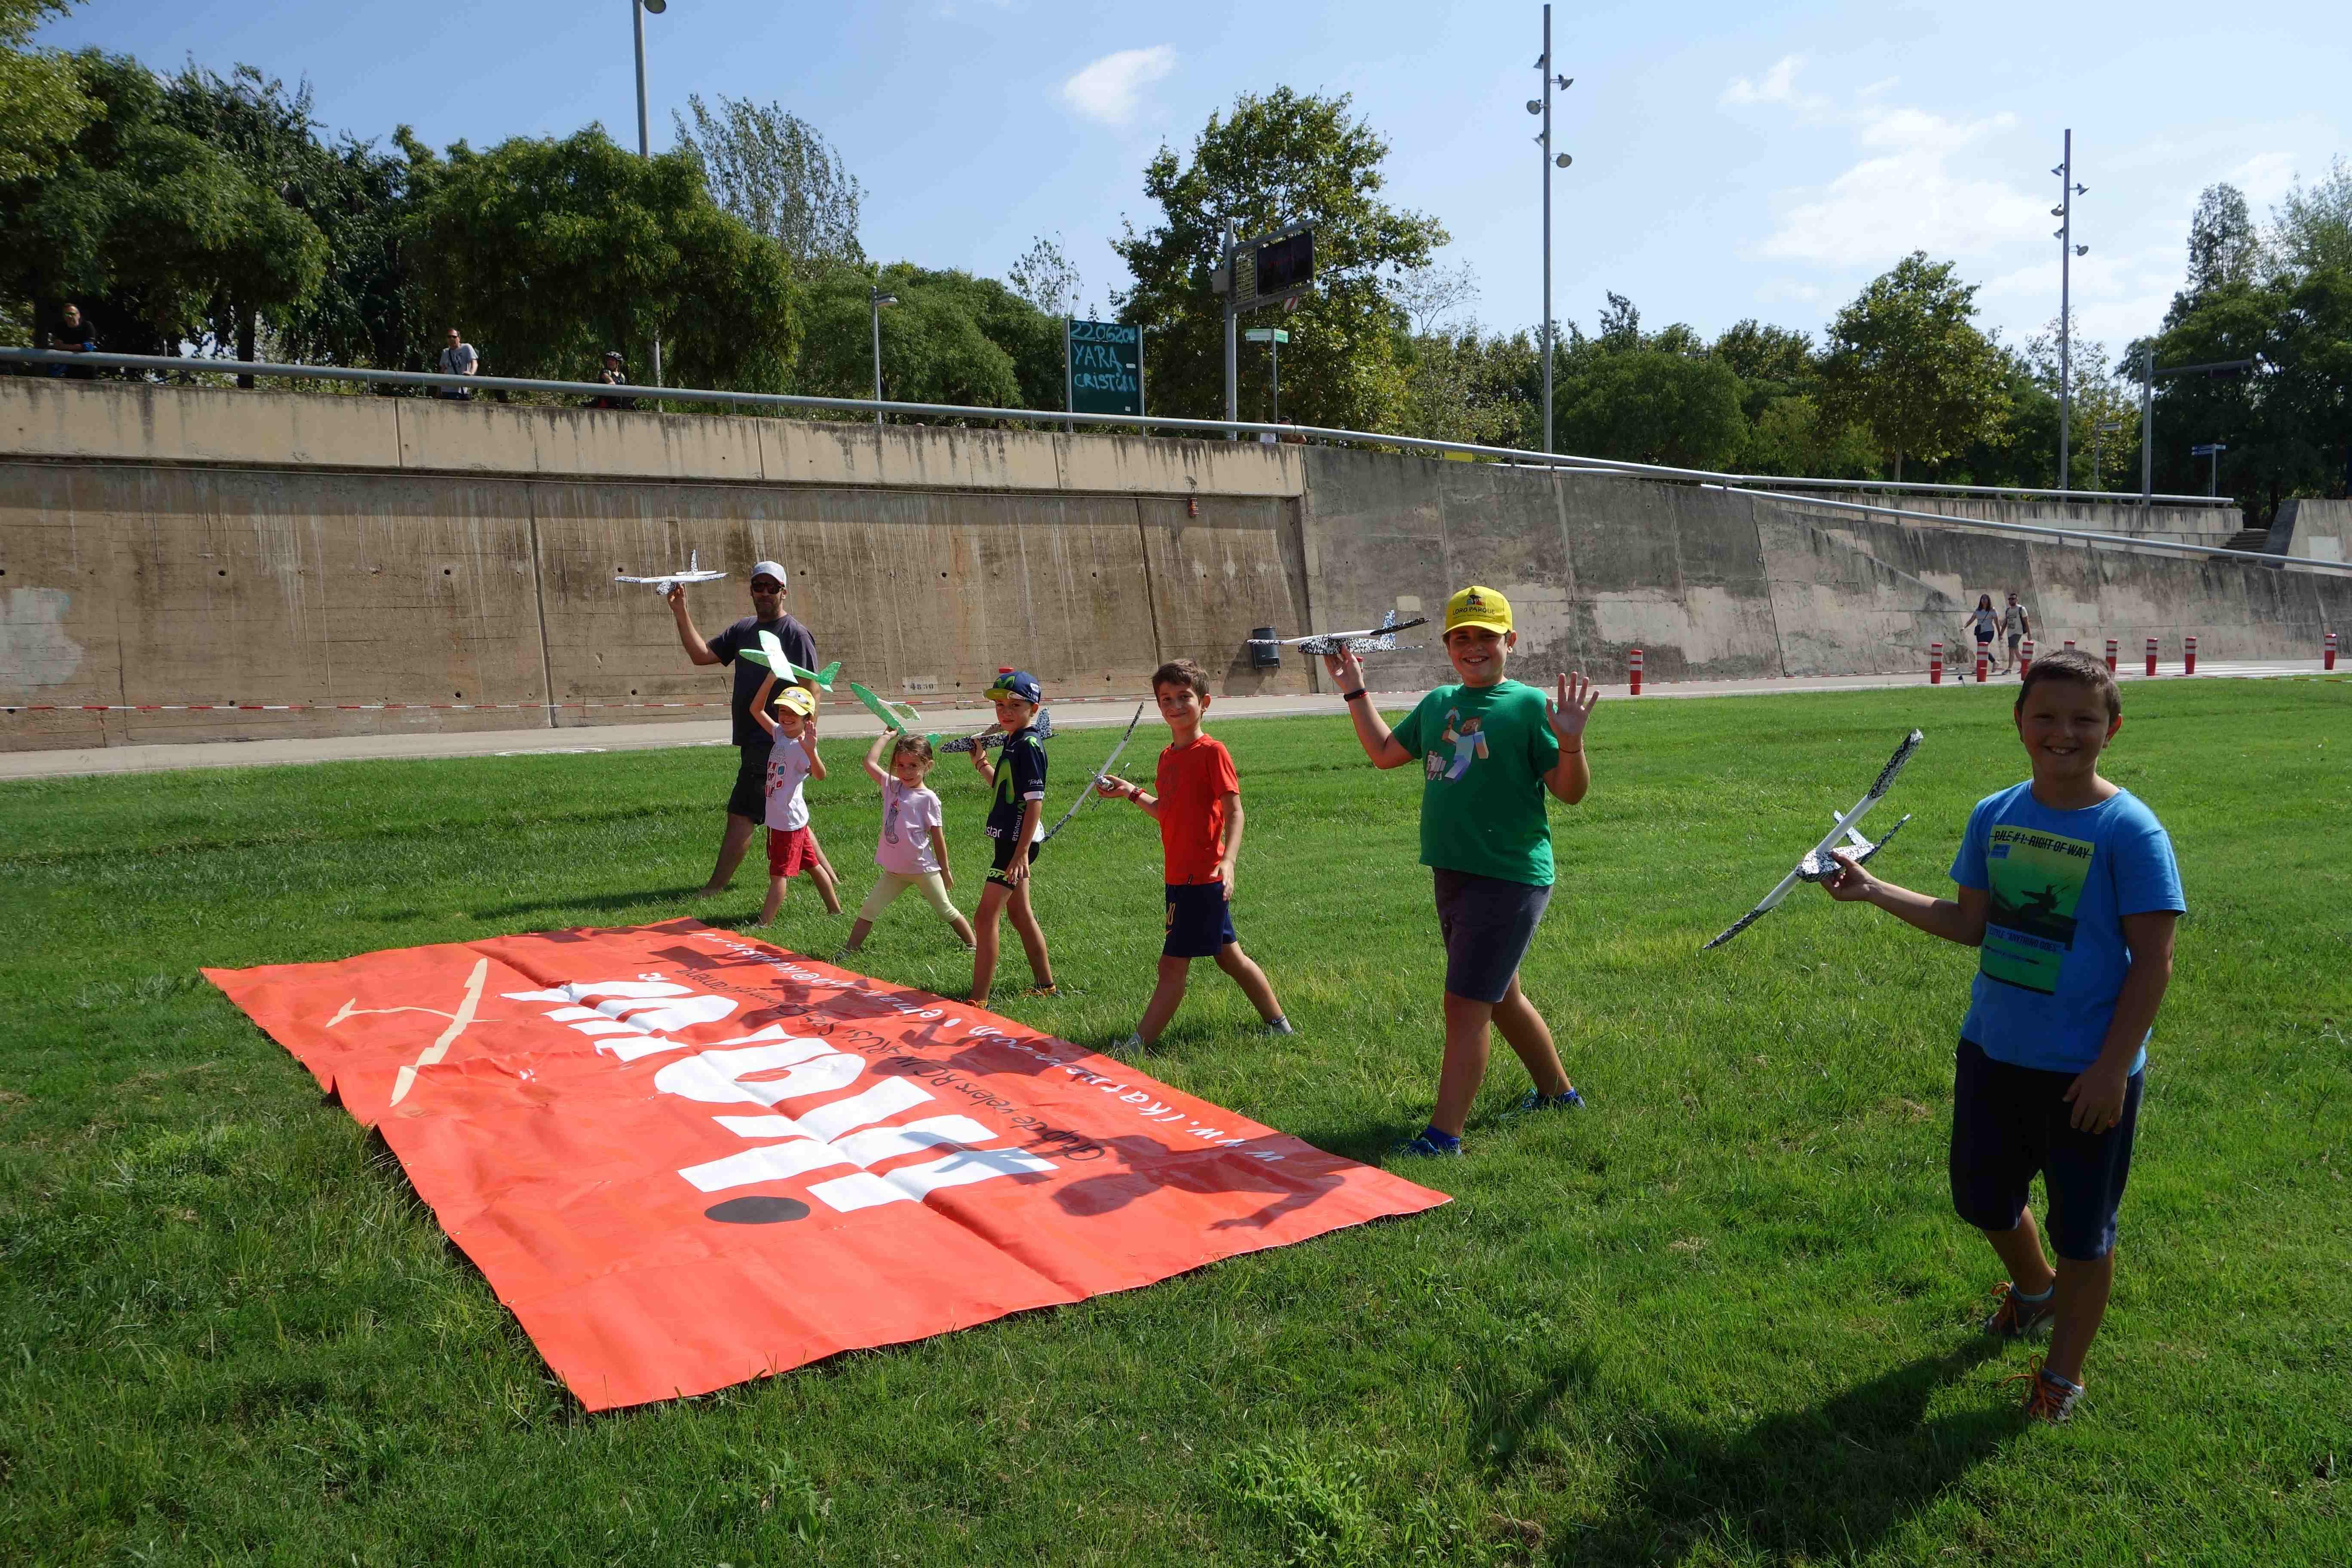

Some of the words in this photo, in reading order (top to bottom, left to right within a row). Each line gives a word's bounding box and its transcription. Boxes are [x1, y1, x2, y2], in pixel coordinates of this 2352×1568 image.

[1453, 607, 1467, 615] LORO
[1469, 606, 1495, 615] PARQUE
[2028, 835, 2054, 850] RIGHT
[2053, 841, 2067, 853] OF
[2067, 844, 2090, 859] WAY
[955, 1083, 1019, 1114] velers
[1010, 1115, 1048, 1133] de
[1041, 1130, 1105, 1161] Grup
